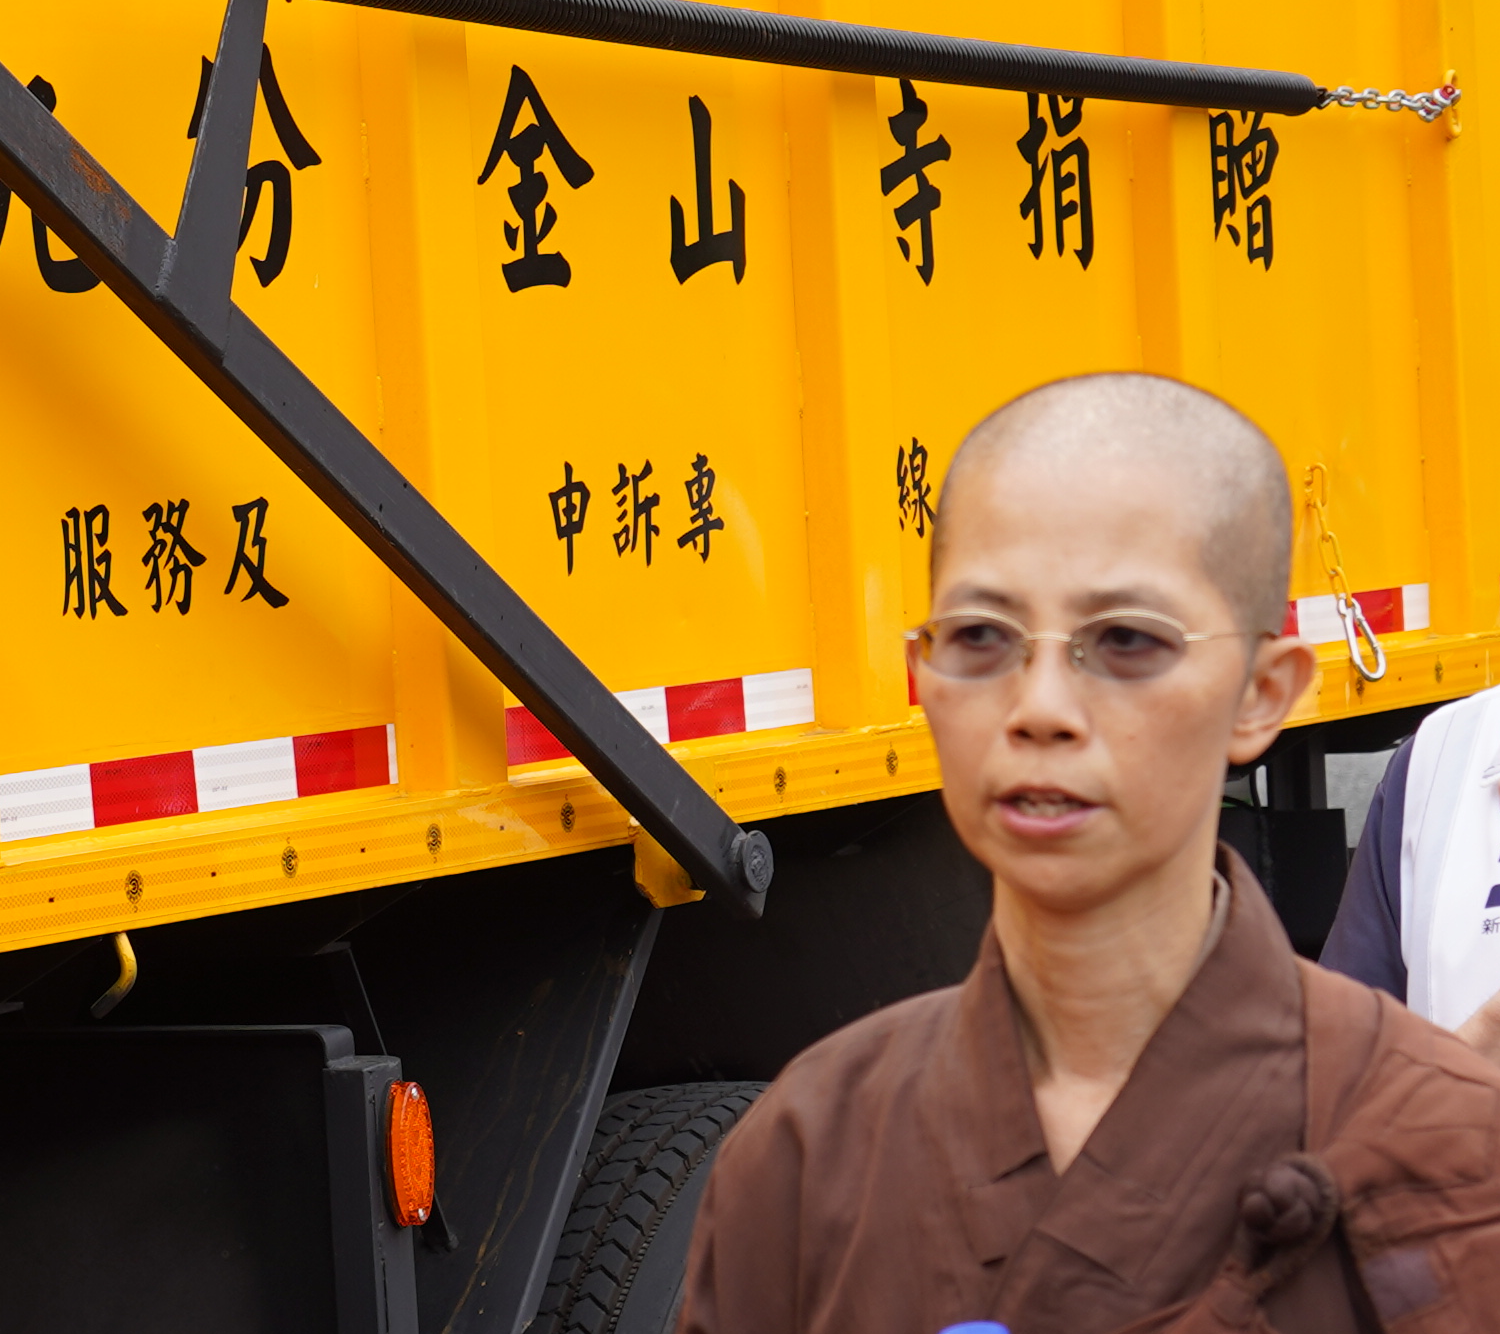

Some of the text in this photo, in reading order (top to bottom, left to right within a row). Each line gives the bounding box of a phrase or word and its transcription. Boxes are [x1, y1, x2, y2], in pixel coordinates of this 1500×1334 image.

[60, 496, 290, 620] 服務及
[548, 452, 725, 576] 申訴專
